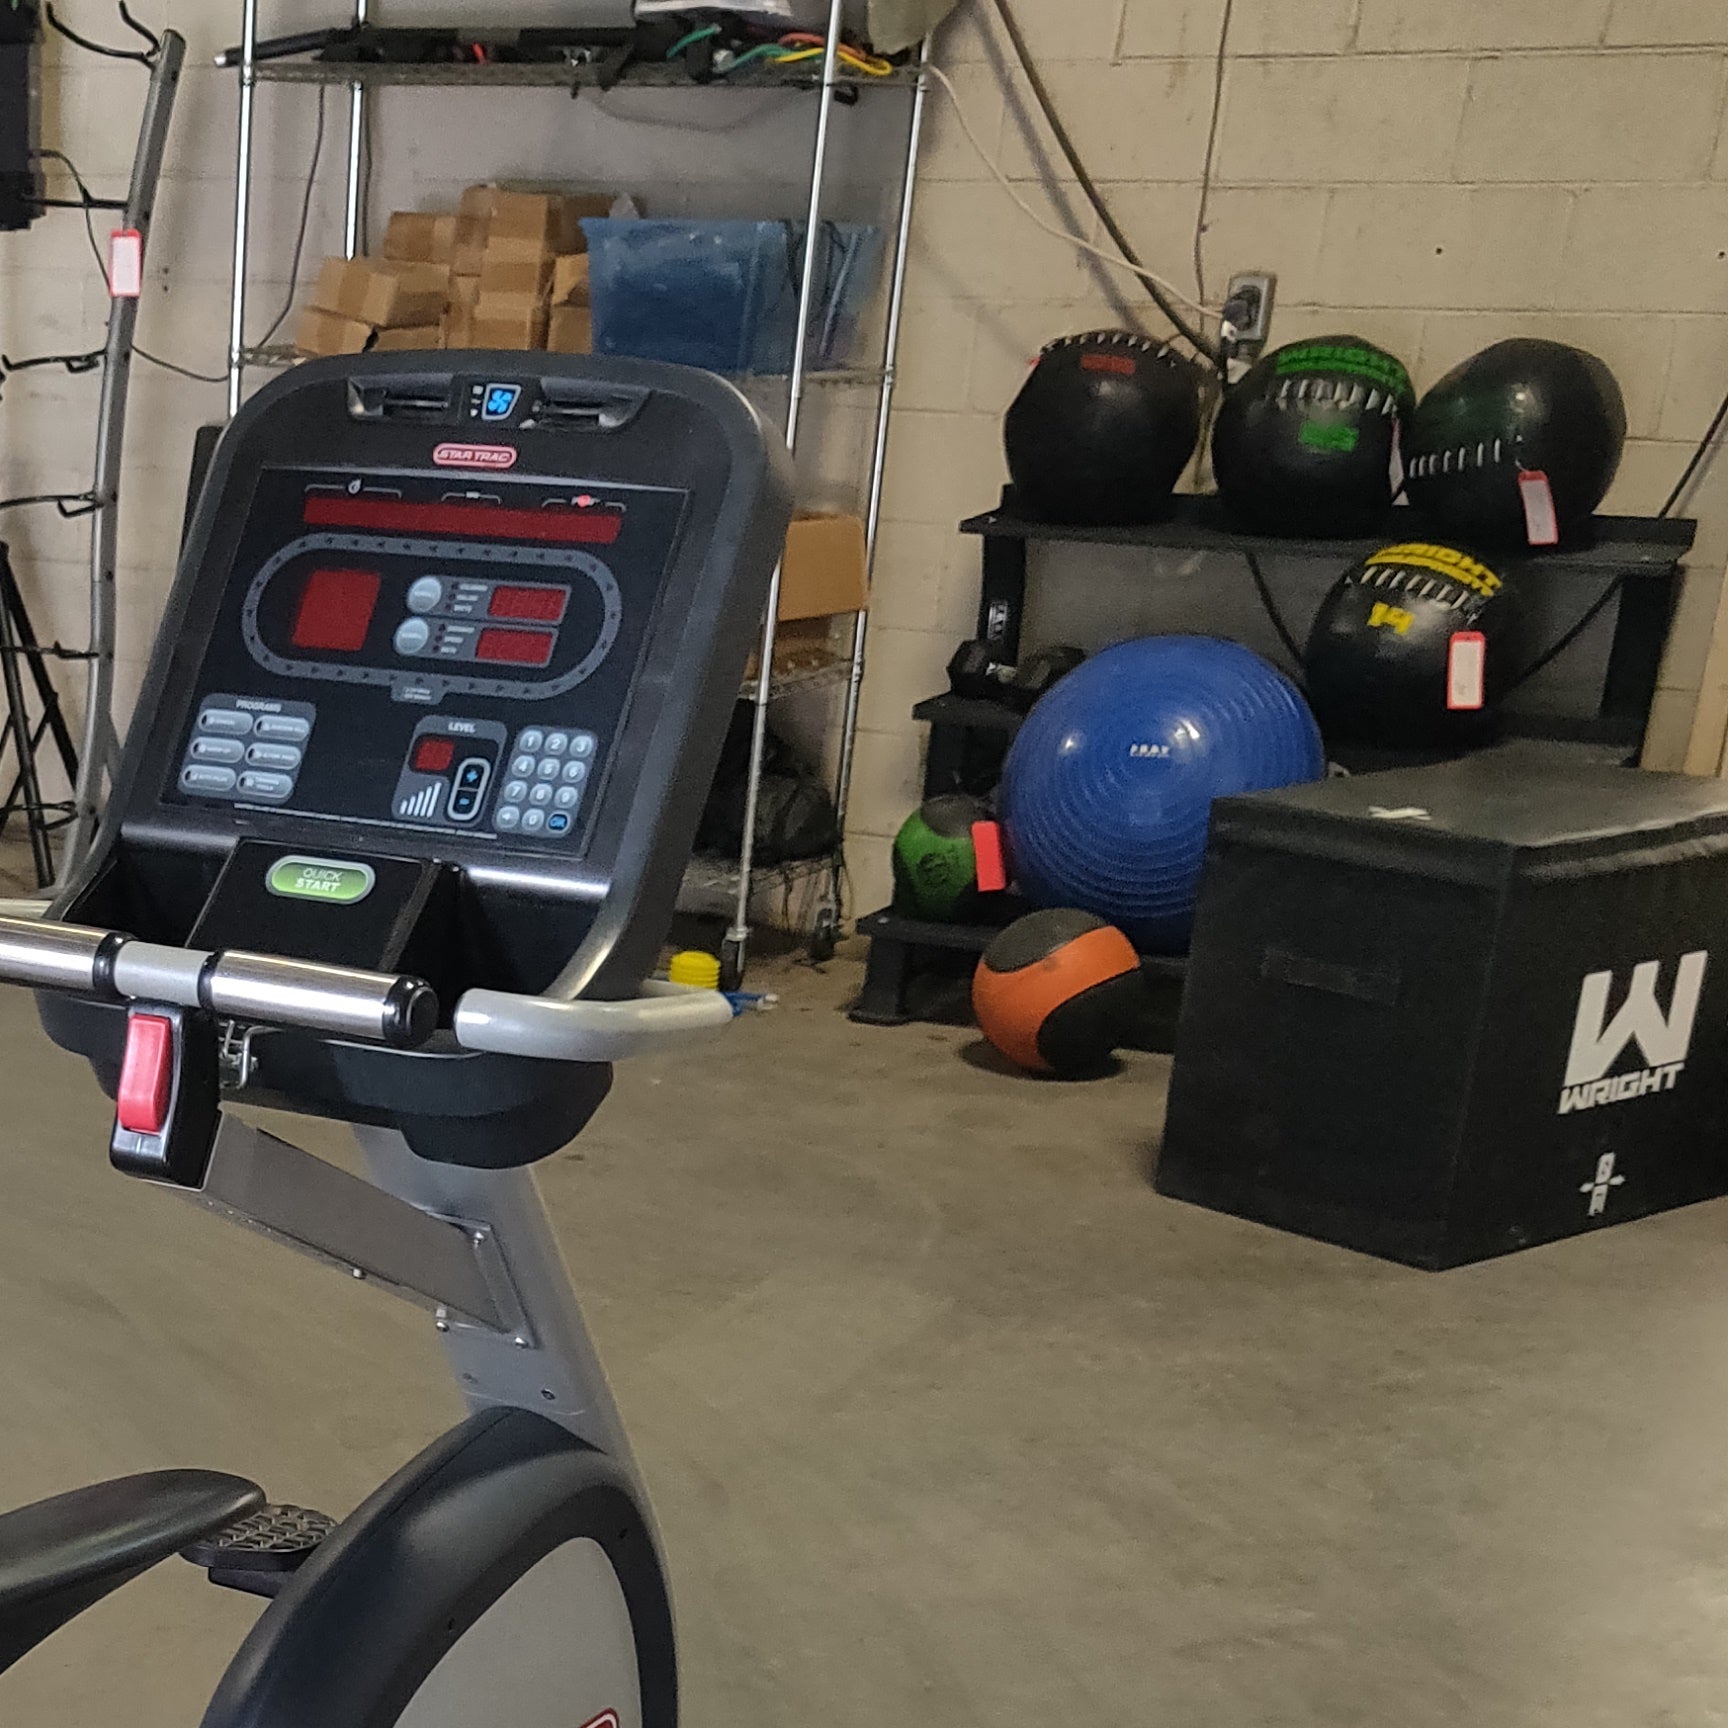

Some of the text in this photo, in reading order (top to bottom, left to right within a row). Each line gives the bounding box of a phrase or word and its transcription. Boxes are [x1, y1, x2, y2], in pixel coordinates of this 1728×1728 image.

[437, 449, 511, 462] STAR TRAC
[447, 721, 476, 733] LEVEL
[303, 868, 343, 881] QUICK
[295, 878, 341, 892] START
[1557, 1062, 1685, 1115] WRIGHT
